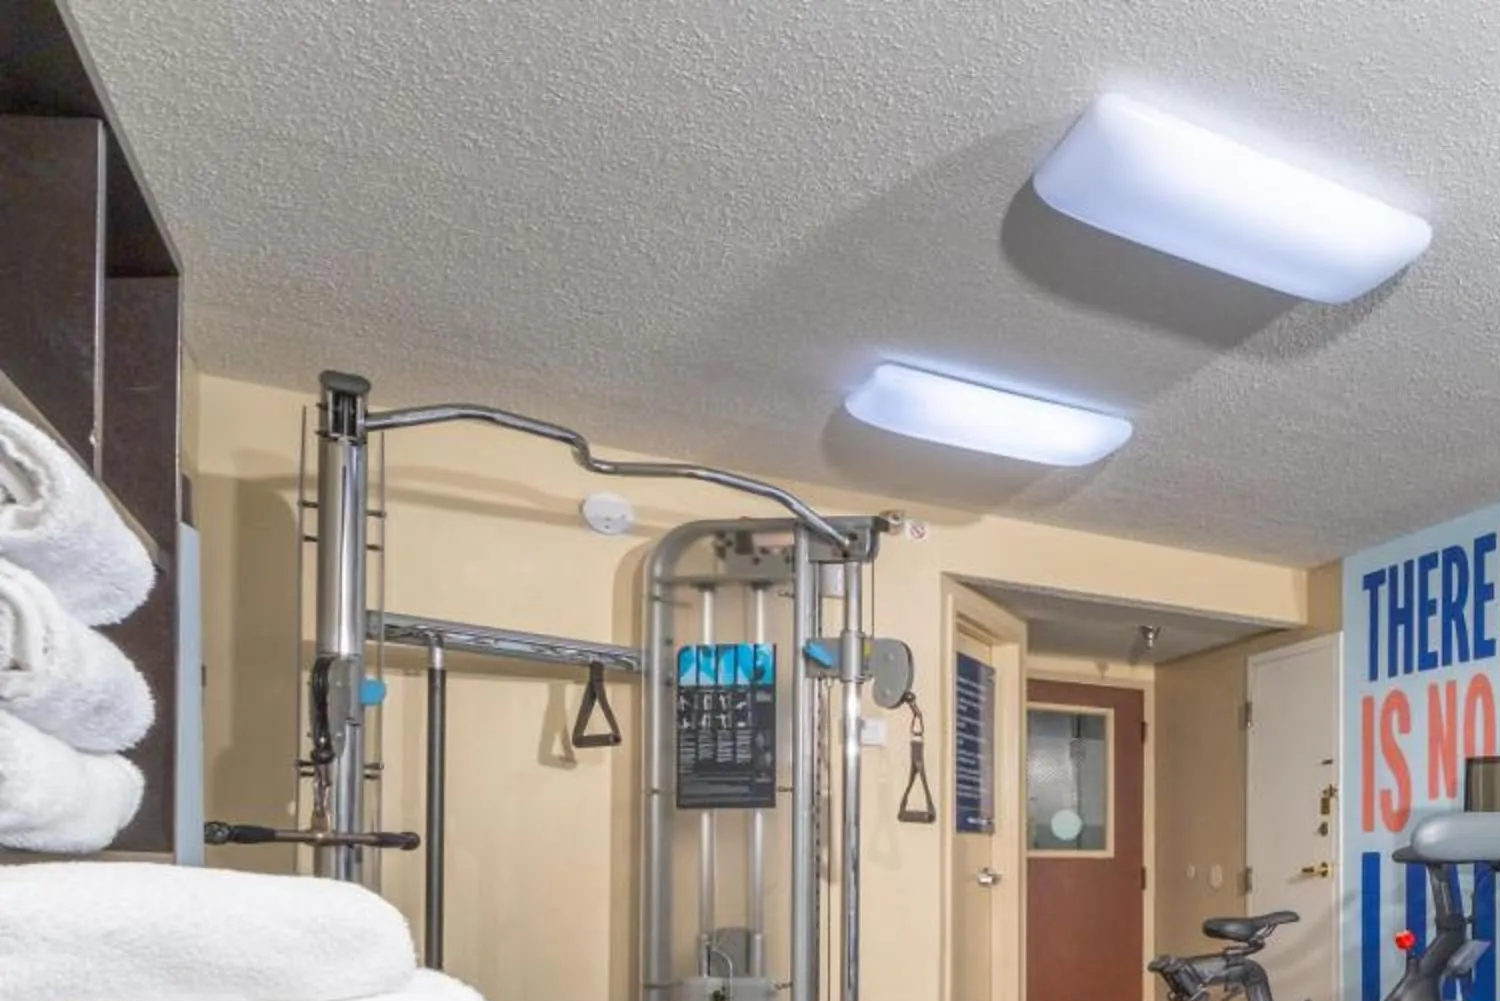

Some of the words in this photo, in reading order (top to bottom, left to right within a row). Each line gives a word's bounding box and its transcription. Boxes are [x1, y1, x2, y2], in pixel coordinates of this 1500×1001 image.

[1363, 533, 1497, 682] THERE
[1362, 689, 1412, 834] IS
[1427, 673, 1497, 801] NO
